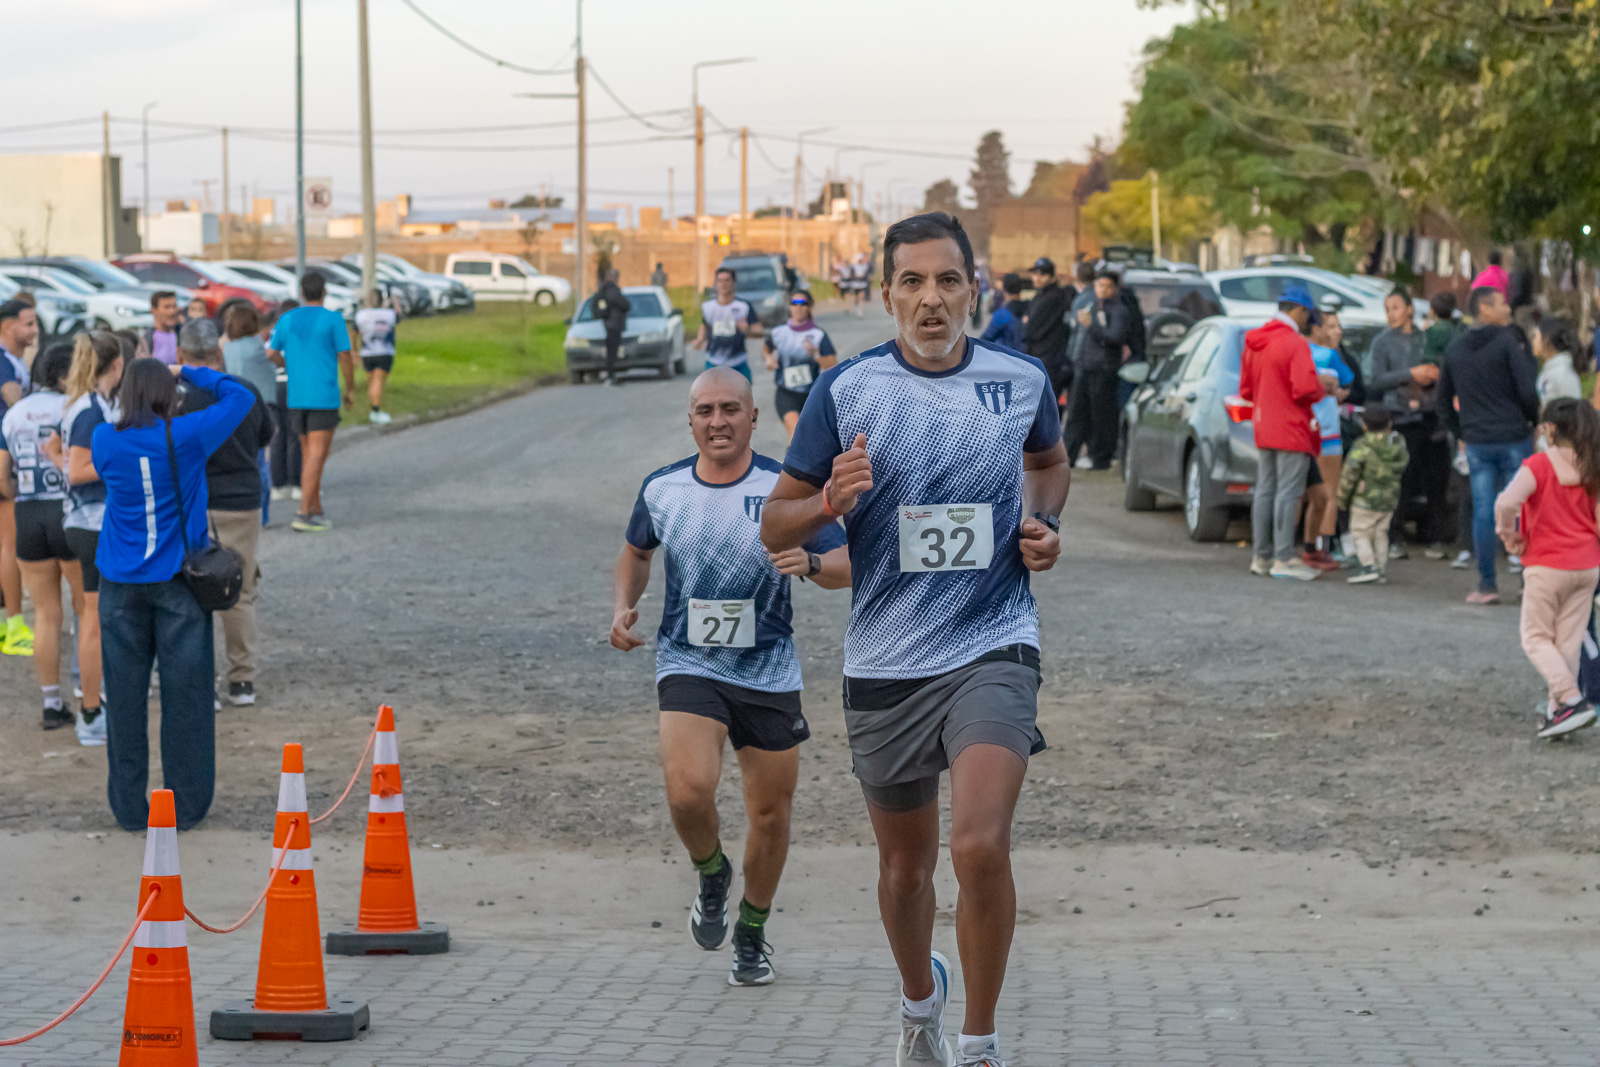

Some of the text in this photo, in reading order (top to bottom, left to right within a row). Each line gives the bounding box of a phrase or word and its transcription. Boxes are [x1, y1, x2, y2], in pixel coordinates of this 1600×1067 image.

[981, 384, 1005, 393] SFC
[920, 526, 976, 568] 32
[702, 616, 740, 644] 27
[131, 1033, 178, 1041] CONOFLEX
